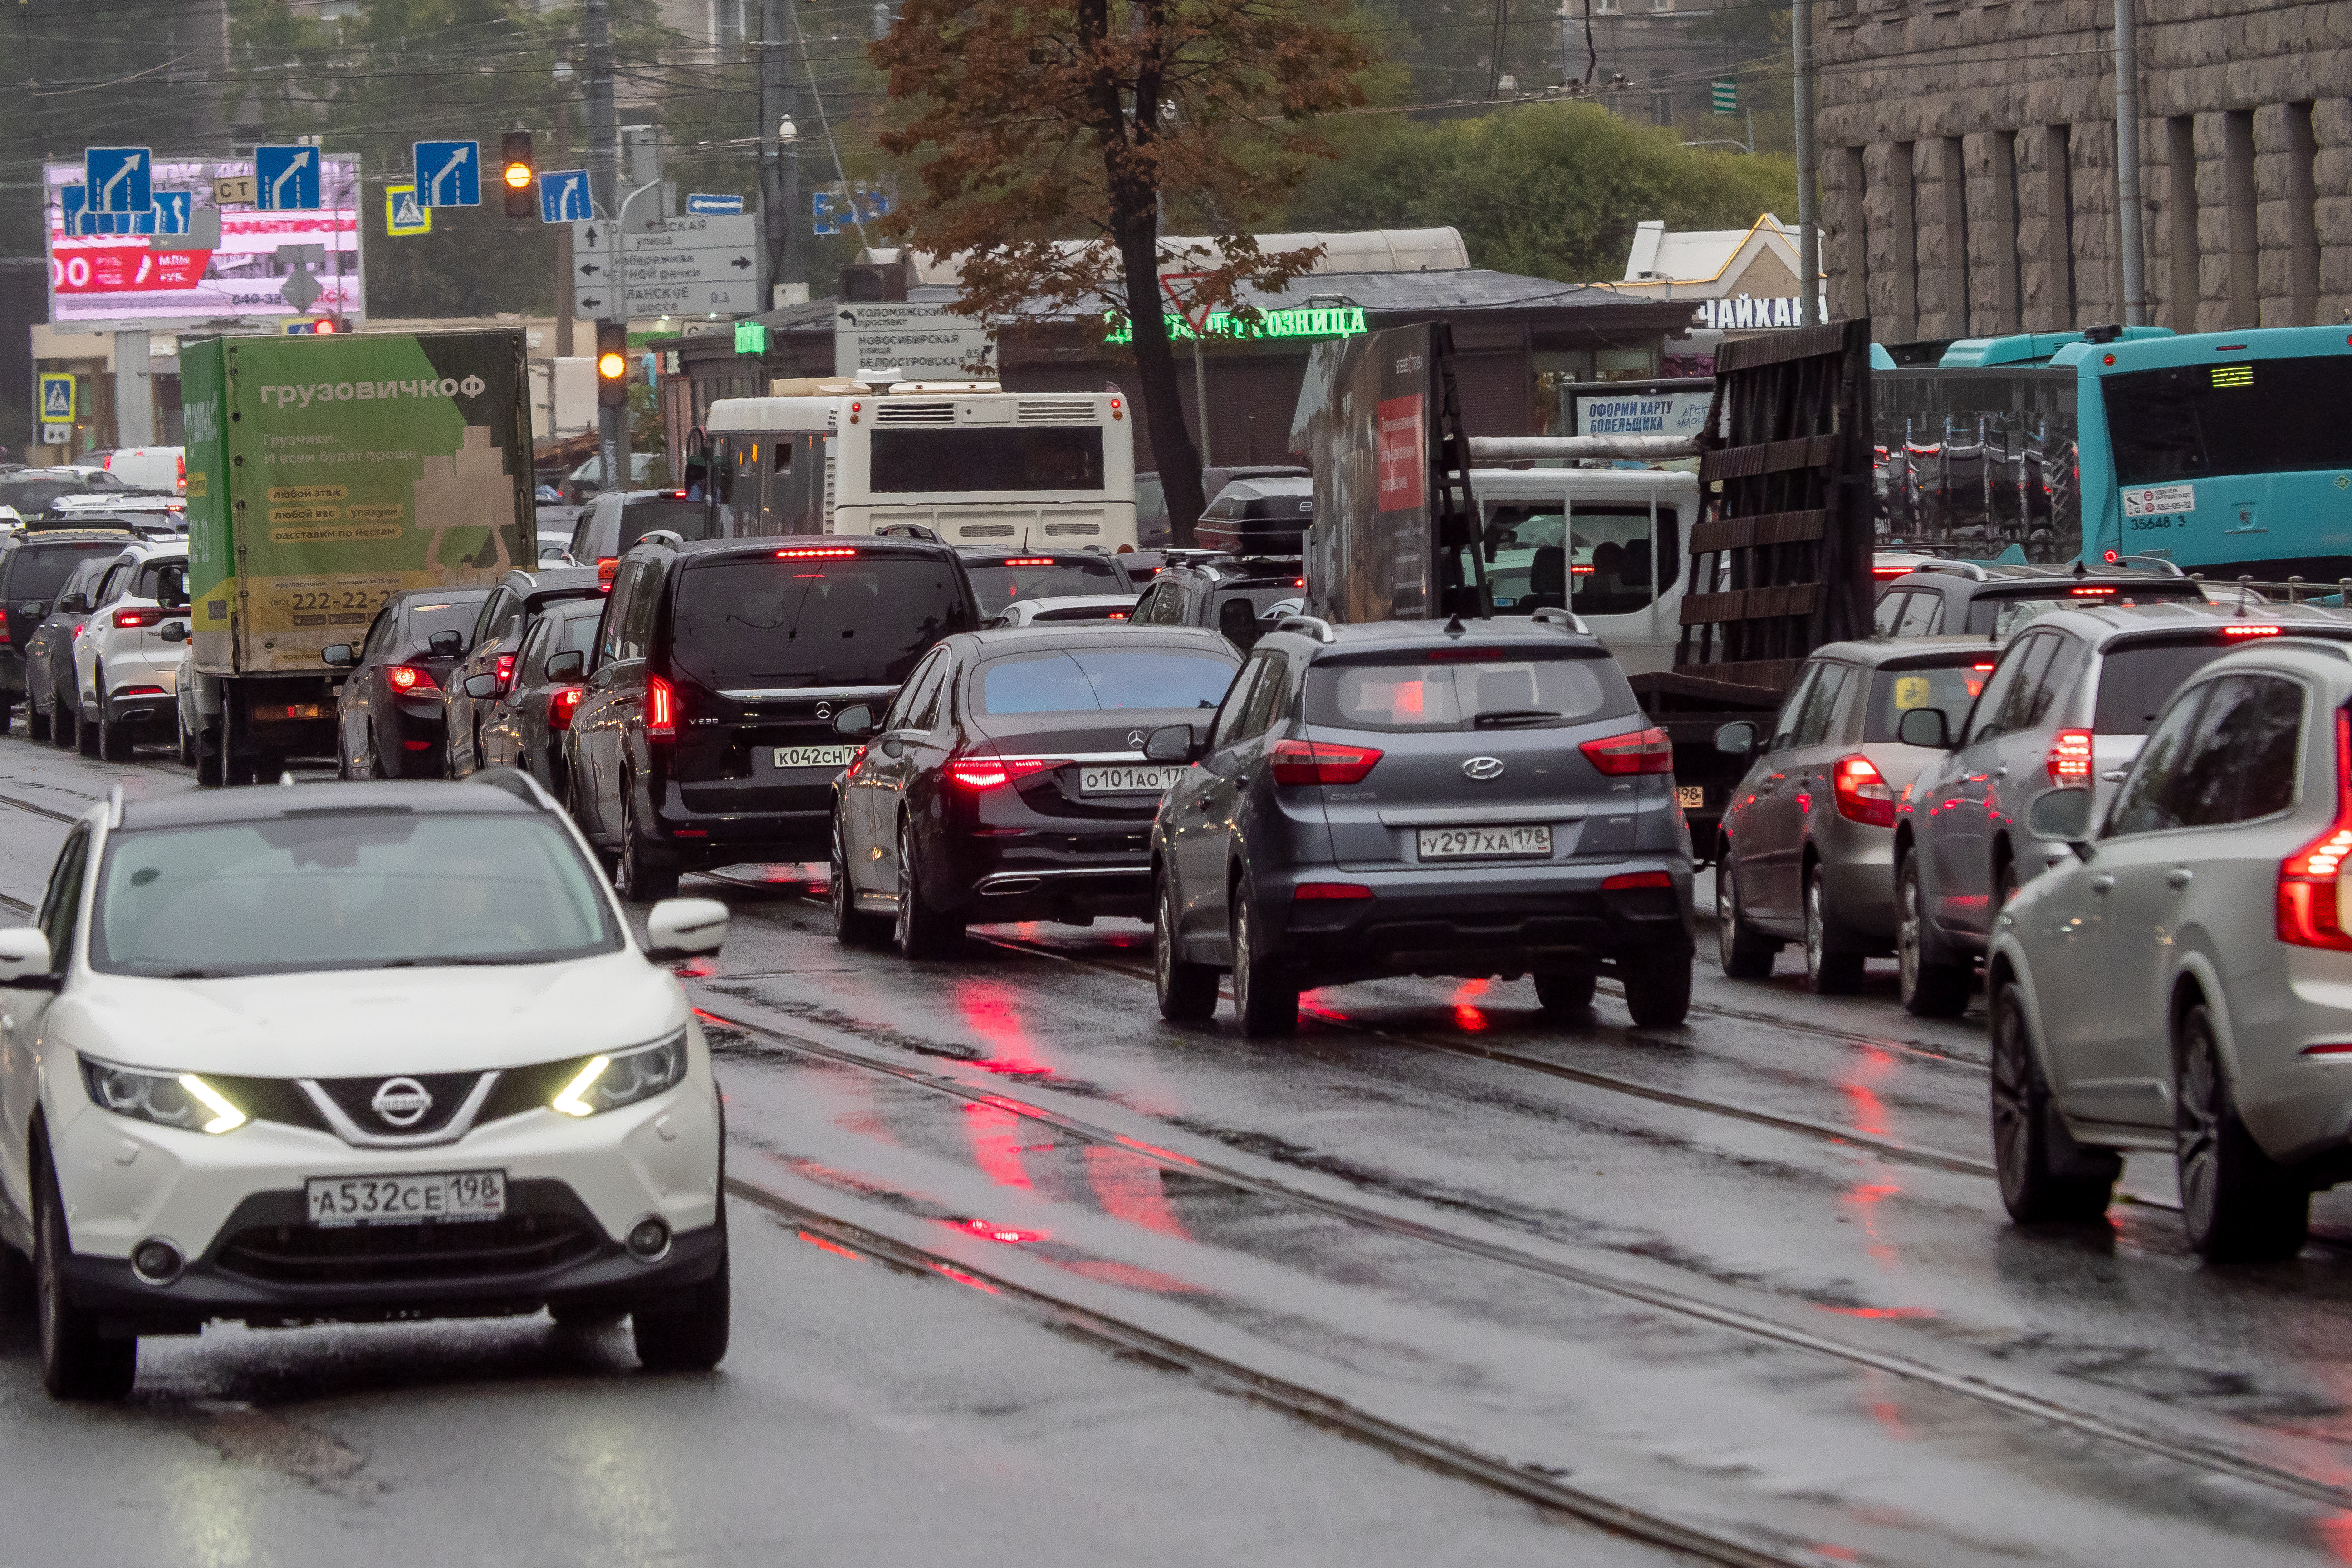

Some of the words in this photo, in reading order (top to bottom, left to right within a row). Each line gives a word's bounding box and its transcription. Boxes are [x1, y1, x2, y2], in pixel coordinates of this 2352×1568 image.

[636, 303, 679, 313] шоссе
[857, 318, 906, 329] проспект
[859, 334, 959, 345] НОВОСИБИРСКАЯ
[860, 357, 965, 367] БЕЛООСТРОВСКАЯ
[1589, 402, 1637, 417] ОФОРМИ
[1640, 400, 1674, 415] КАРТУ
[1590, 416, 1664, 433] БОЛЕЛЬЩИКА
[279, 453, 315, 464] всем
[319, 450, 363, 465] будет
[274, 489, 312, 499] любой
[315, 488, 342, 497] этаж
[274, 509, 313, 519] любой
[316, 509, 335, 518] вес
[350, 507, 398, 519] упакуем
[2132, 516, 2171, 531] 35648
[2178, 515, 2186, 527] 3
[275, 530, 335, 541] расставим
[338, 529, 353, 537] по
[355, 527, 395, 537] местам
[292, 590, 401, 611] 222-22-2
[779, 748, 843, 766] К042СН
[1086, 769, 1159, 788] О101АО
[1428, 831, 1510, 853] У297ХА
[1513, 828, 1544, 845] 178
[318, 1180, 442, 1215] А532СЕ
[450, 1178, 495, 1205] 198
